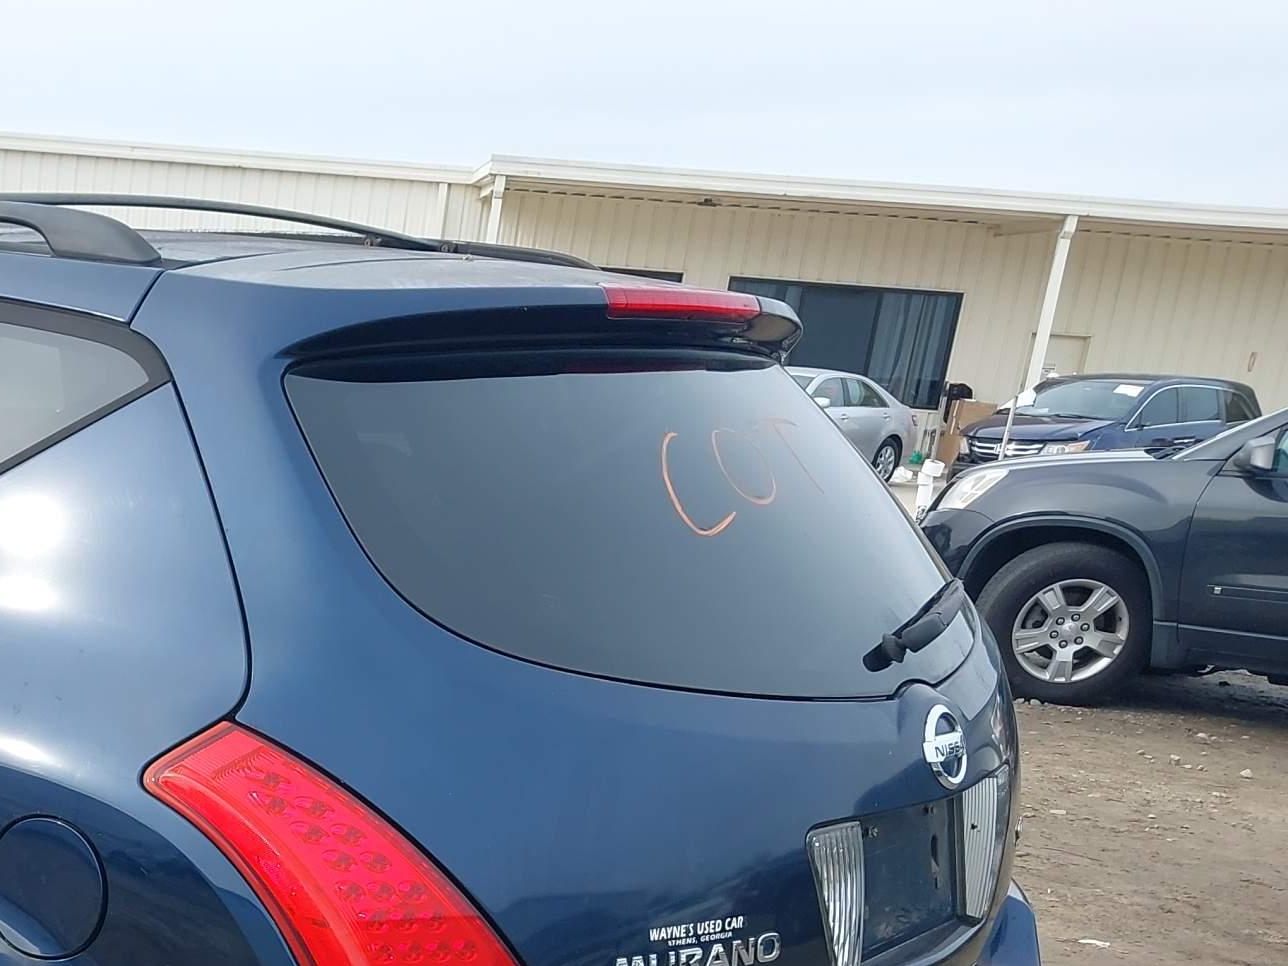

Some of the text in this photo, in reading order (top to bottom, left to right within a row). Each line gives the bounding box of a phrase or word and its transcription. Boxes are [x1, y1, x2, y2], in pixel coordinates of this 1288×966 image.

[649, 923, 694, 941] WAYNE'S
[697, 919, 722, 935] USED
[700, 931, 733, 942] GEORGIA
